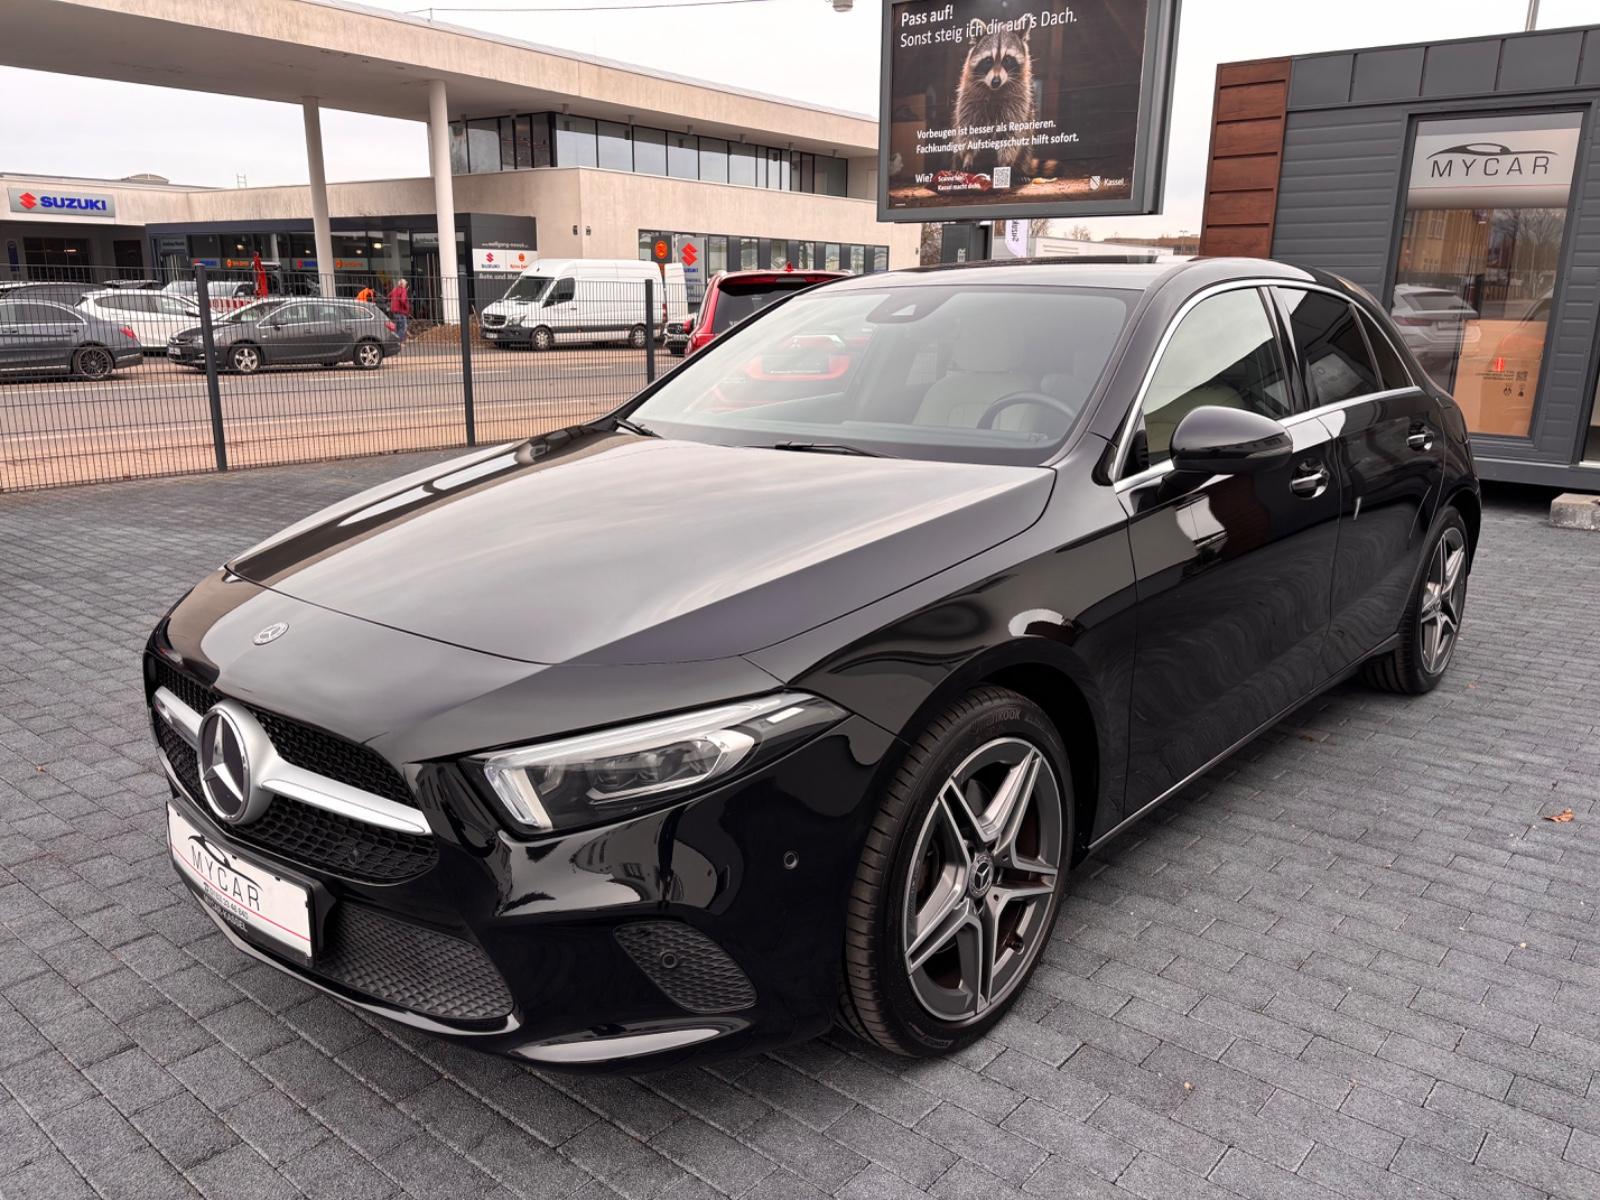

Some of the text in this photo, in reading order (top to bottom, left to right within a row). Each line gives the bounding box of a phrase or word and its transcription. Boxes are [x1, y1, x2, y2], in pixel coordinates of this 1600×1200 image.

[901, 4, 954, 27] Pass auf!
[900, 30, 932, 48] Sonst
[935, 25, 963, 43] steig
[966, 22, 984, 38] ich
[986, 18, 1004, 35] dir
[1041, 7, 1078, 27] Dach.
[917, 119, 1056, 140] Vorbeugen ist besser als Reparieren.
[916, 132, 1080, 154] Fachkundiger Aufstiegsschutz hilft sofort.
[915, 173, 934, 183] Wie?
[1431, 156, 1550, 178] MYCAR
[40, 196, 107, 211] SUZUKI
[191, 845, 261, 912] MYCAR
